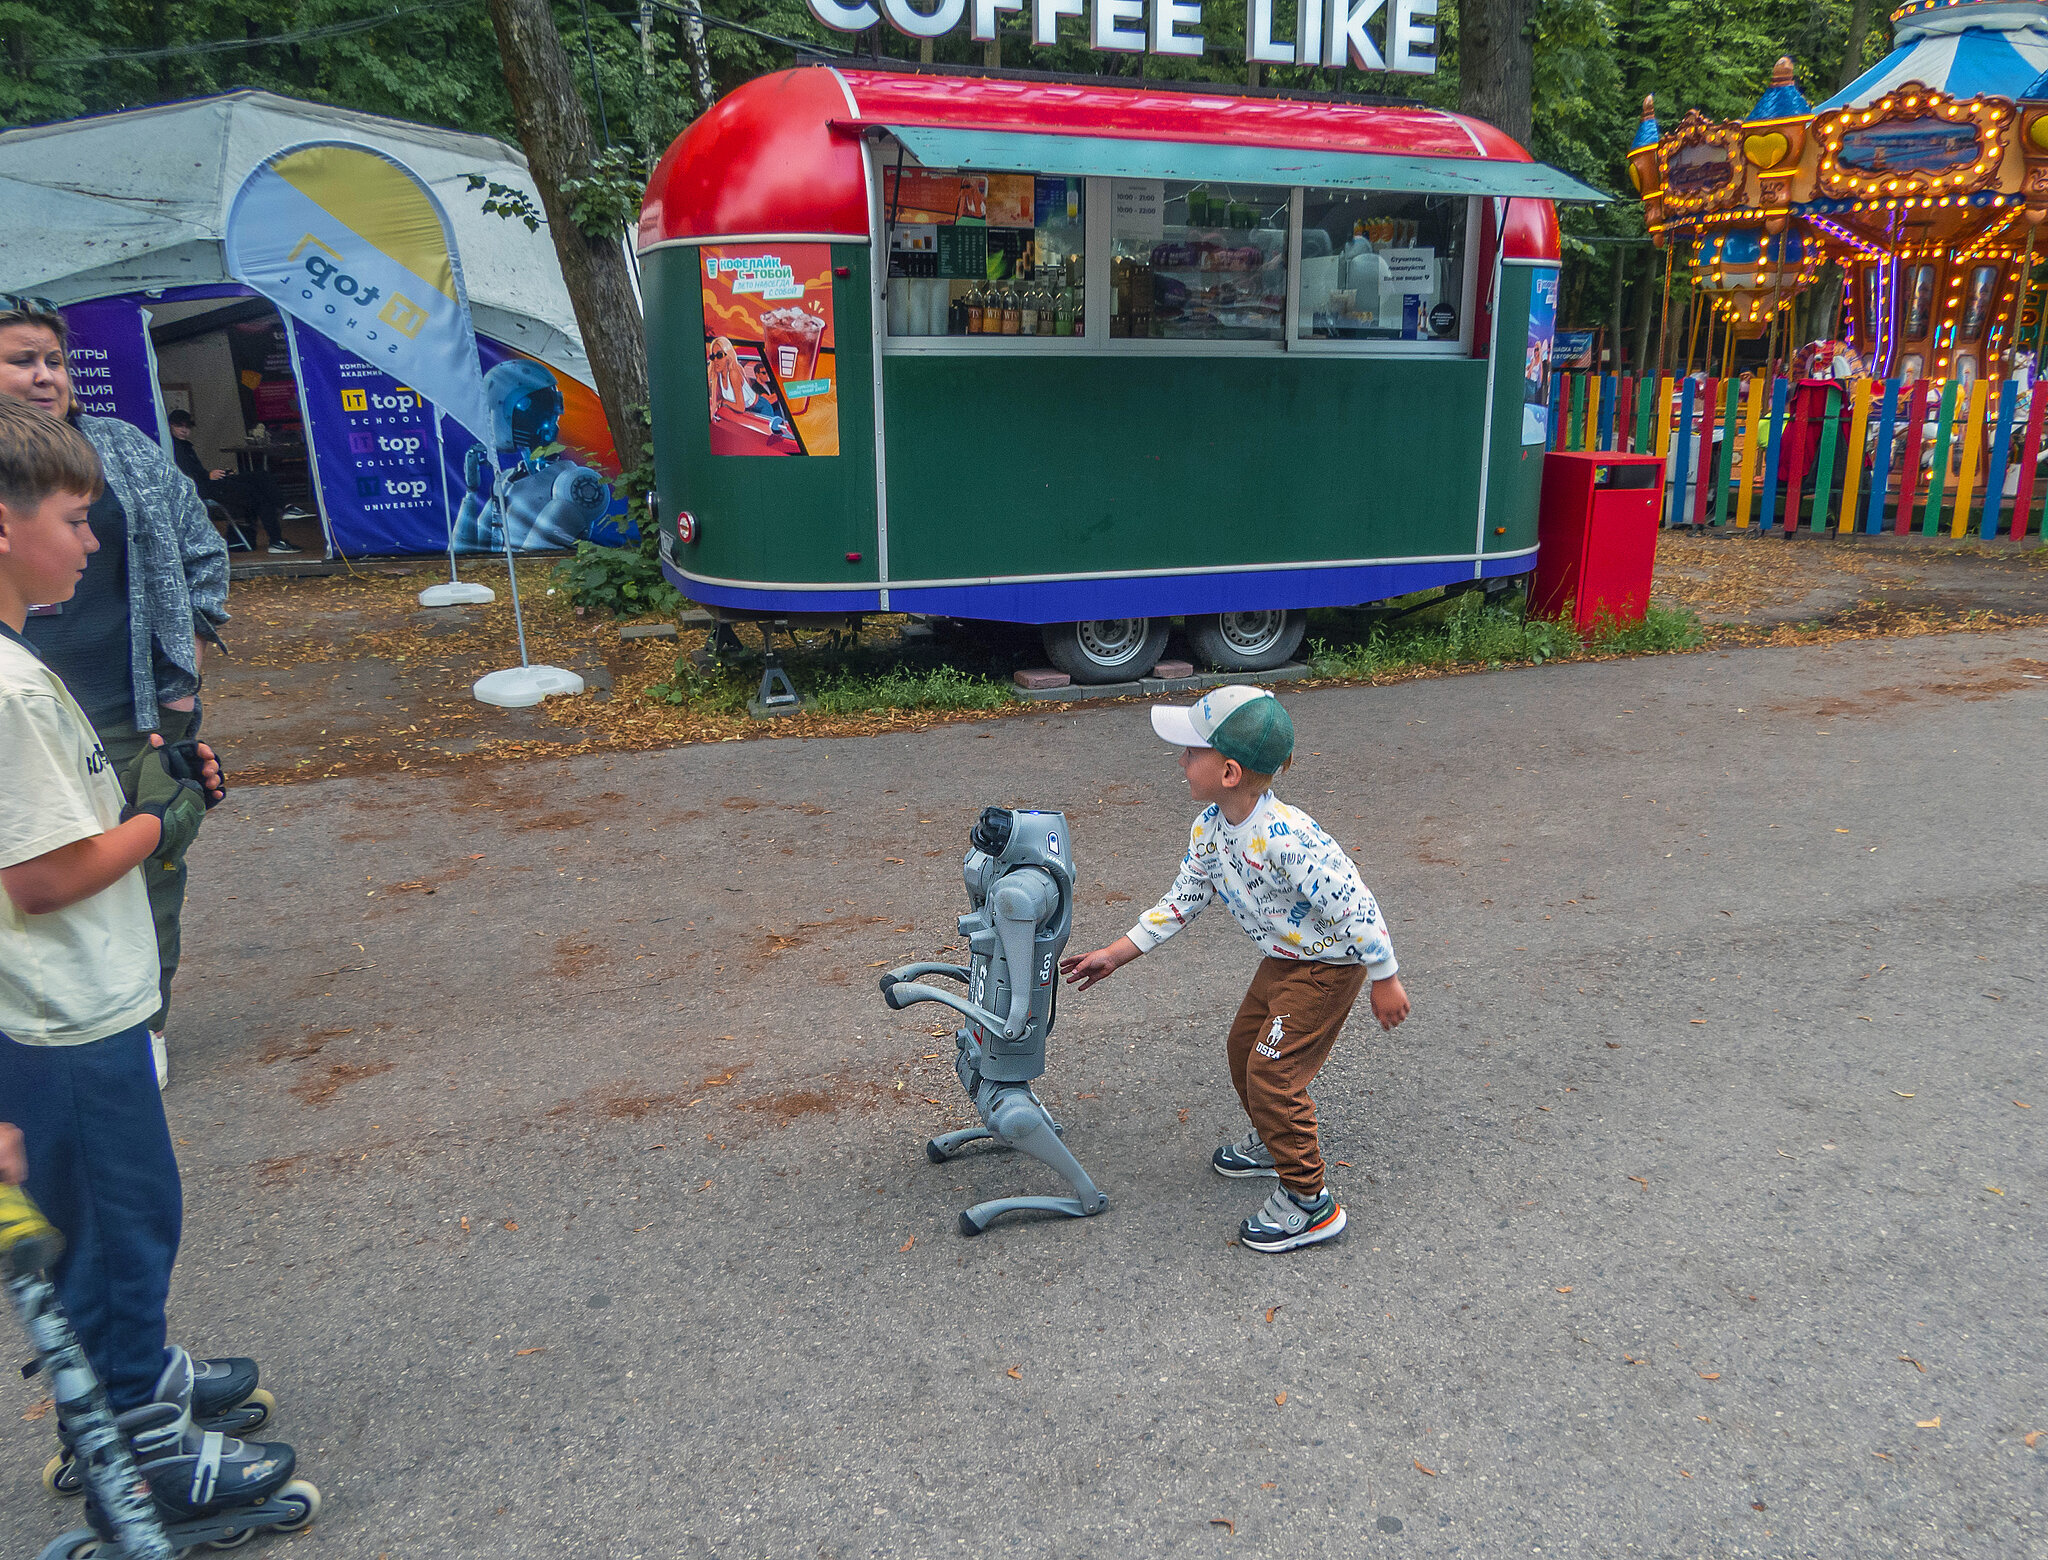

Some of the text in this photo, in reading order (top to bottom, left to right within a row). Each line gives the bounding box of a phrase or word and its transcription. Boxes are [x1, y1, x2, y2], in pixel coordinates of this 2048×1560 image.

[1246, 0, 1437, 75] LIKE
[720, 257, 780, 271] КОФЕЛАЙК
[753, 266, 792, 279] ТОБОЙ
[68, 367, 111, 378] АНИЕ
[341, 370, 383, 378] АКАДЕМИЯ
[83, 402, 117, 413] НАЯ
[371, 393, 414, 413] top
[350, 415, 421, 426] SCHOOL
[378, 436, 420, 455] top
[356, 457, 426, 468] COLLEGE
[385, 479, 428, 498] top
[364, 500, 433, 512] UNIVERSITY
[1303, 931, 1342, 957] COOL
[1040, 951, 1053, 981] top
[1255, 1041, 1282, 1060] USPA
